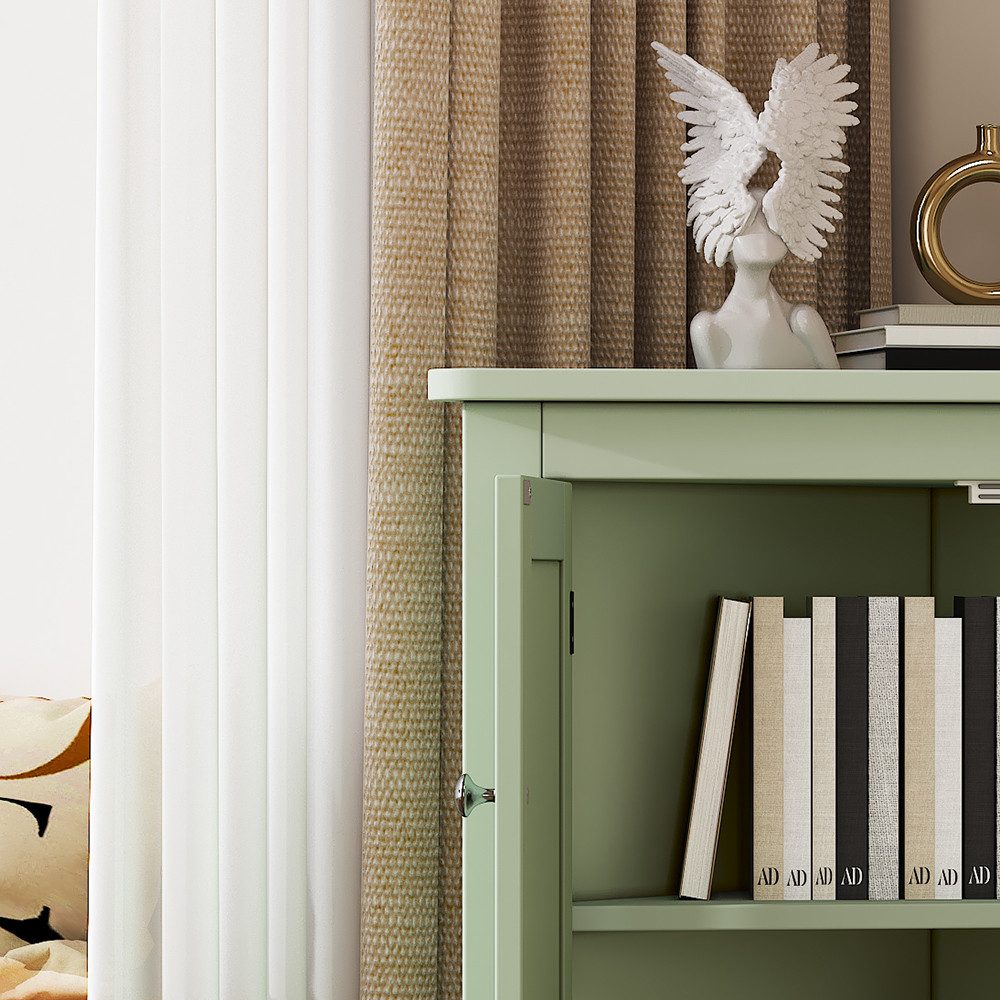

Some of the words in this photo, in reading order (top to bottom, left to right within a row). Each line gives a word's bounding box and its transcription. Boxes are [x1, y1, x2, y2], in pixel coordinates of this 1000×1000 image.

[757, 867, 780, 886] AD
[786, 869, 807, 887] AD
[815, 867, 833, 886] AD
[840, 866, 863, 886] AD
[908, 866, 931, 885] AD
[937, 868, 958, 886] AD
[968, 865, 990, 885] AD
